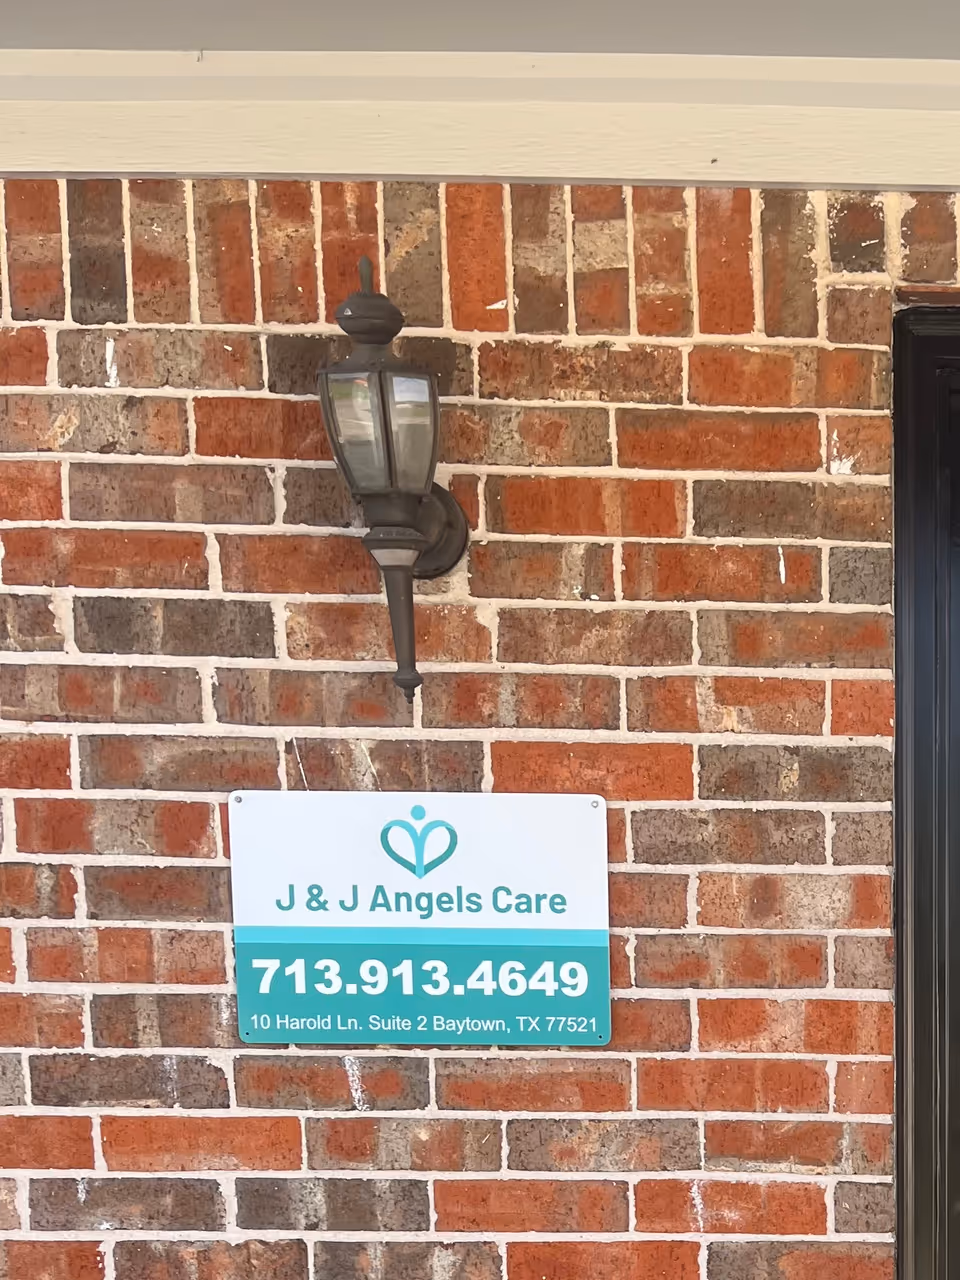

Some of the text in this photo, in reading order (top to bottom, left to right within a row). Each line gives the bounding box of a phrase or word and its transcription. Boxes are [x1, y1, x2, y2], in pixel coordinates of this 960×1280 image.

[276, 884, 567, 919] J & J Angels Care
[251, 958, 589, 997] 713.913.4649
[250, 1014, 597, 1035] 10 Harold Ln. Suite 2 Baytown, TX 77521
